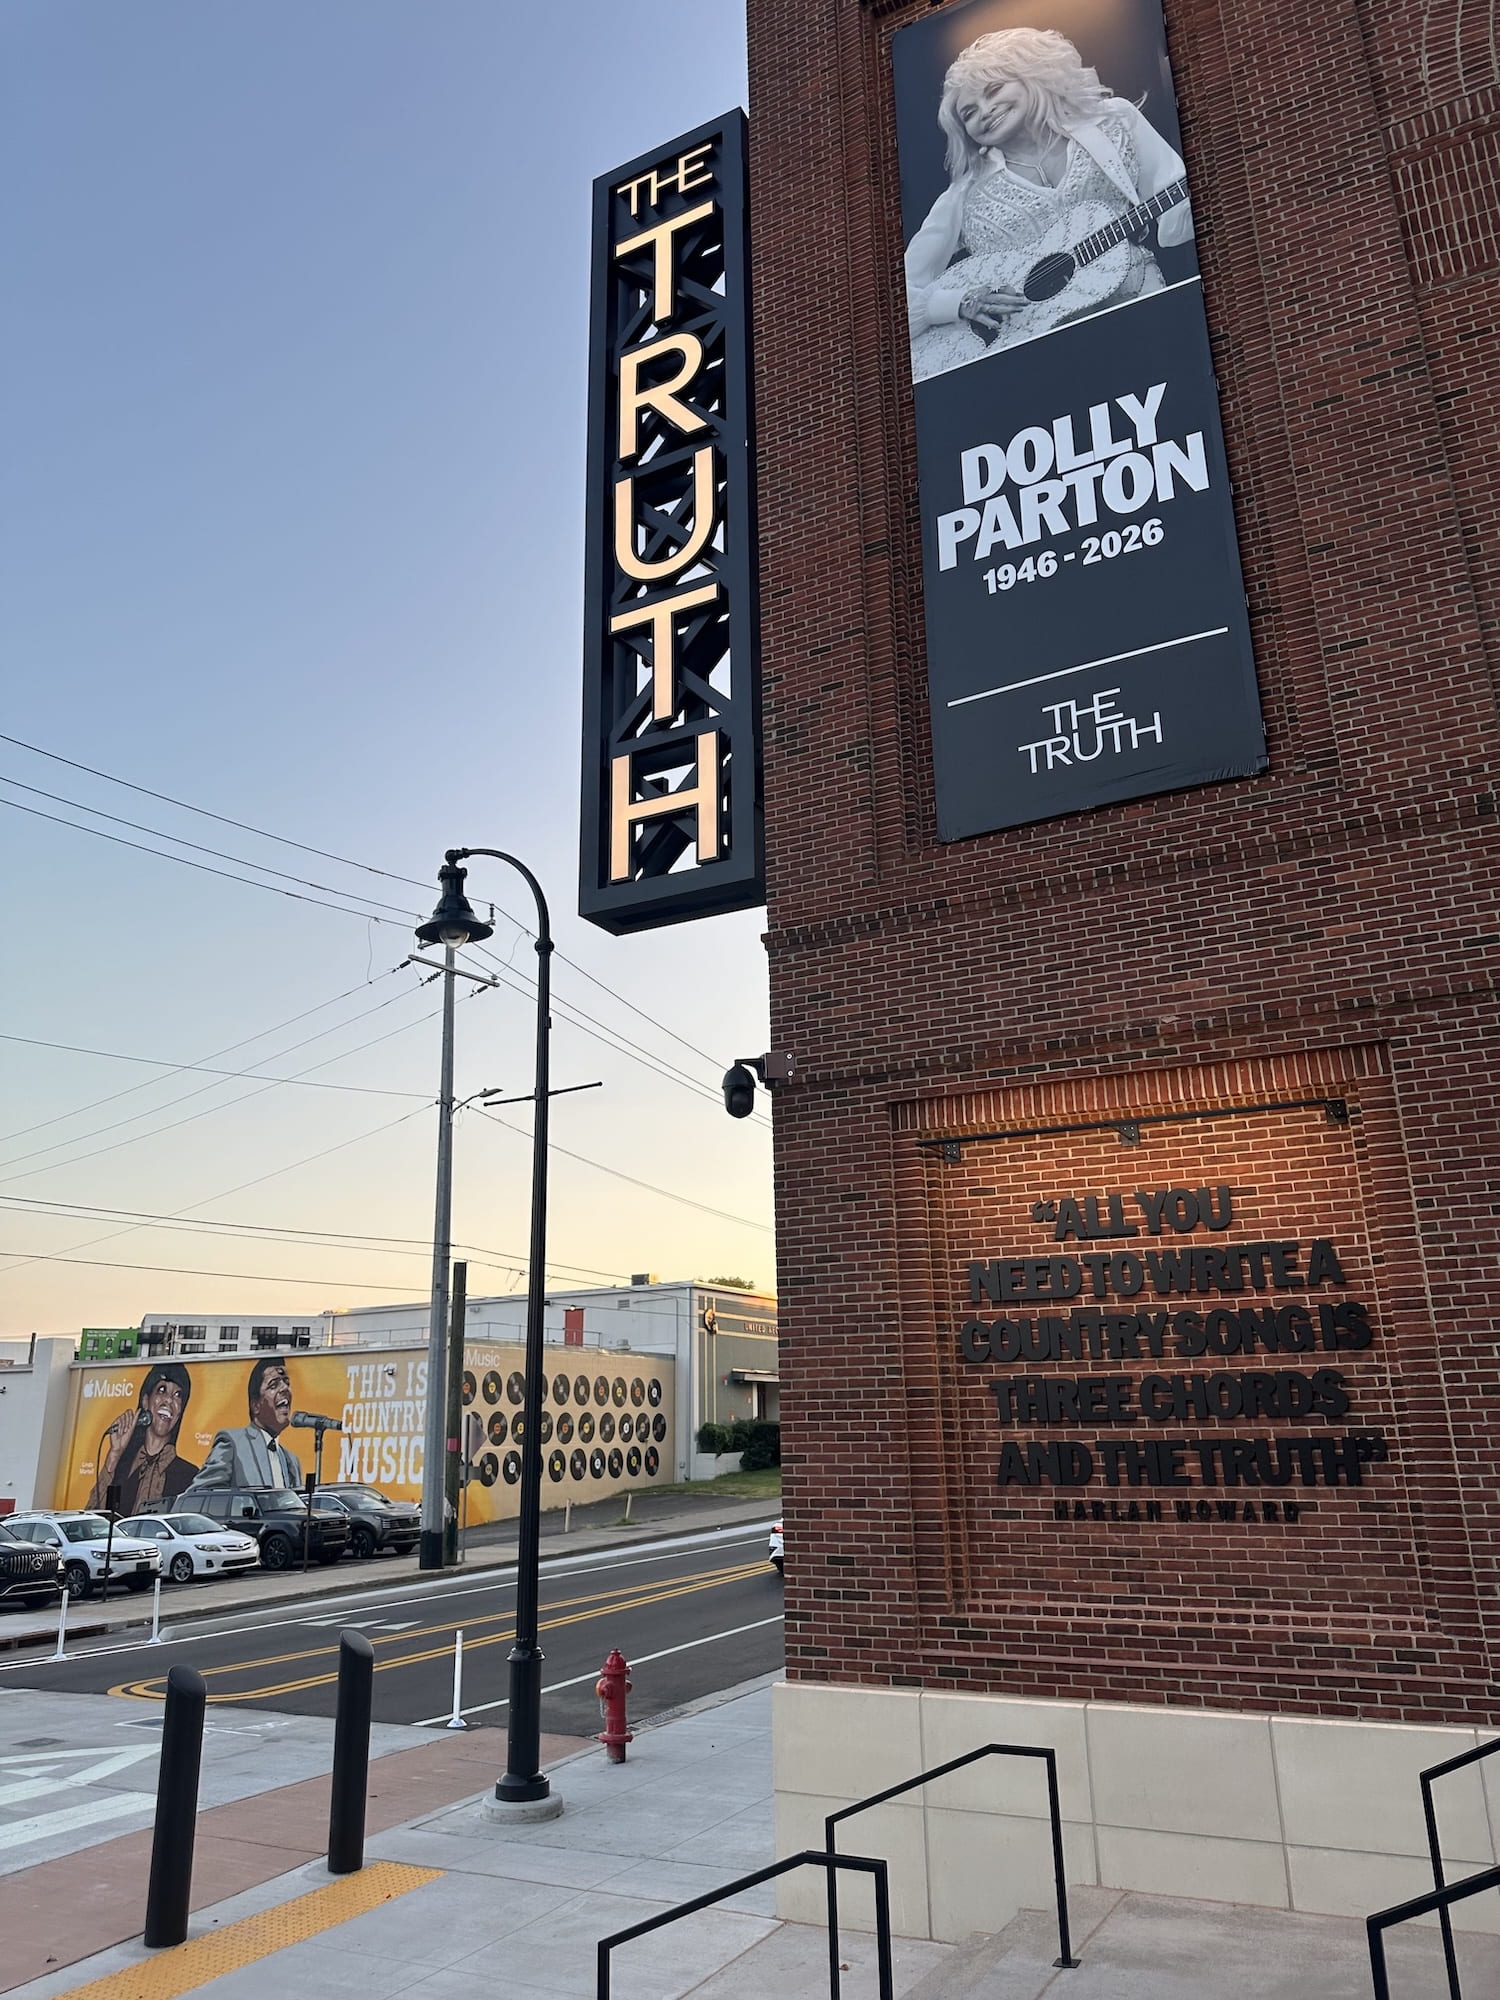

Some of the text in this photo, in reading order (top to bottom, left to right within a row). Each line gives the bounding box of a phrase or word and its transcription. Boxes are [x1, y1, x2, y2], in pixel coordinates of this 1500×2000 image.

[617, 144, 713, 214] THE
[961, 382, 1167, 505] DOLLY
[937, 431, 1210, 571] PARTON
[609, 200, 719, 883] TRUTH
[983, 550, 1058, 594] 1946
[1081, 518, 1165, 565] 2026
[1042, 688, 1123, 734] THE
[1018, 712, 1163, 773] TRUTH
[1135, 1185, 1233, 1233] YOU
[969, 1239, 1346, 1302] NEED TO WRITE A
[465, 1348, 500, 1367] Music
[961, 1301, 1373, 1362] COUNTRY SONG IS
[94, 1378, 134, 1398] Music
[346, 1360, 429, 1399] THIS IS
[990, 1369, 1351, 1424] THREE CHORDS
[341, 1399, 427, 1434] COUNTRY
[337, 1435, 425, 1485] MUSIC
[998, 1441, 1093, 1487] AND
[1097, 1439, 1192, 1487] THE
[1055, 1500, 1299, 1523] HARLAN HOWARD
